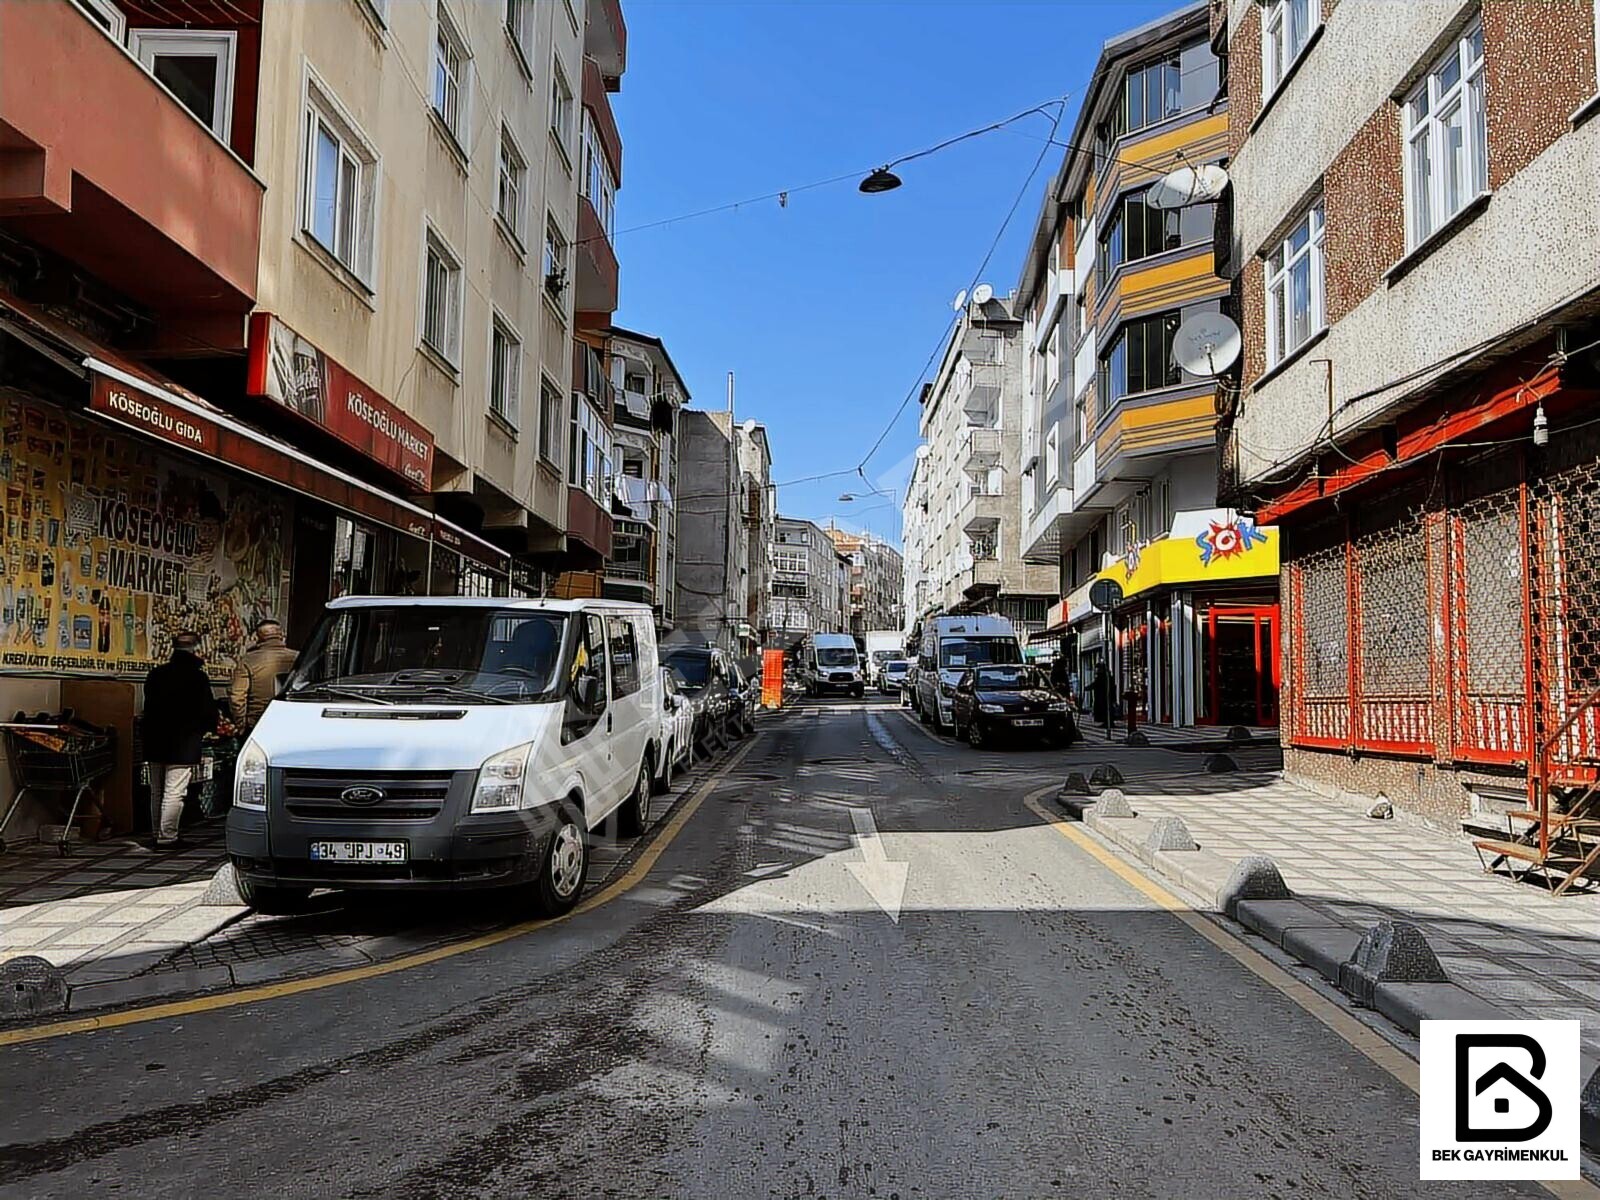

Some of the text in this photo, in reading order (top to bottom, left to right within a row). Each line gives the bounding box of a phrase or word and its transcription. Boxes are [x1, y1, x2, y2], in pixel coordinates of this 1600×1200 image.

[109, 391, 203, 443] KÖSEOĞLU GIDA
[347, 391, 398, 440] KÖSEOĞLU
[98, 491, 196, 557] KÖSEOĞLU
[108, 547, 184, 598] MARKET
[320, 844, 336, 859] 34
[384, 844, 402, 859] 49
